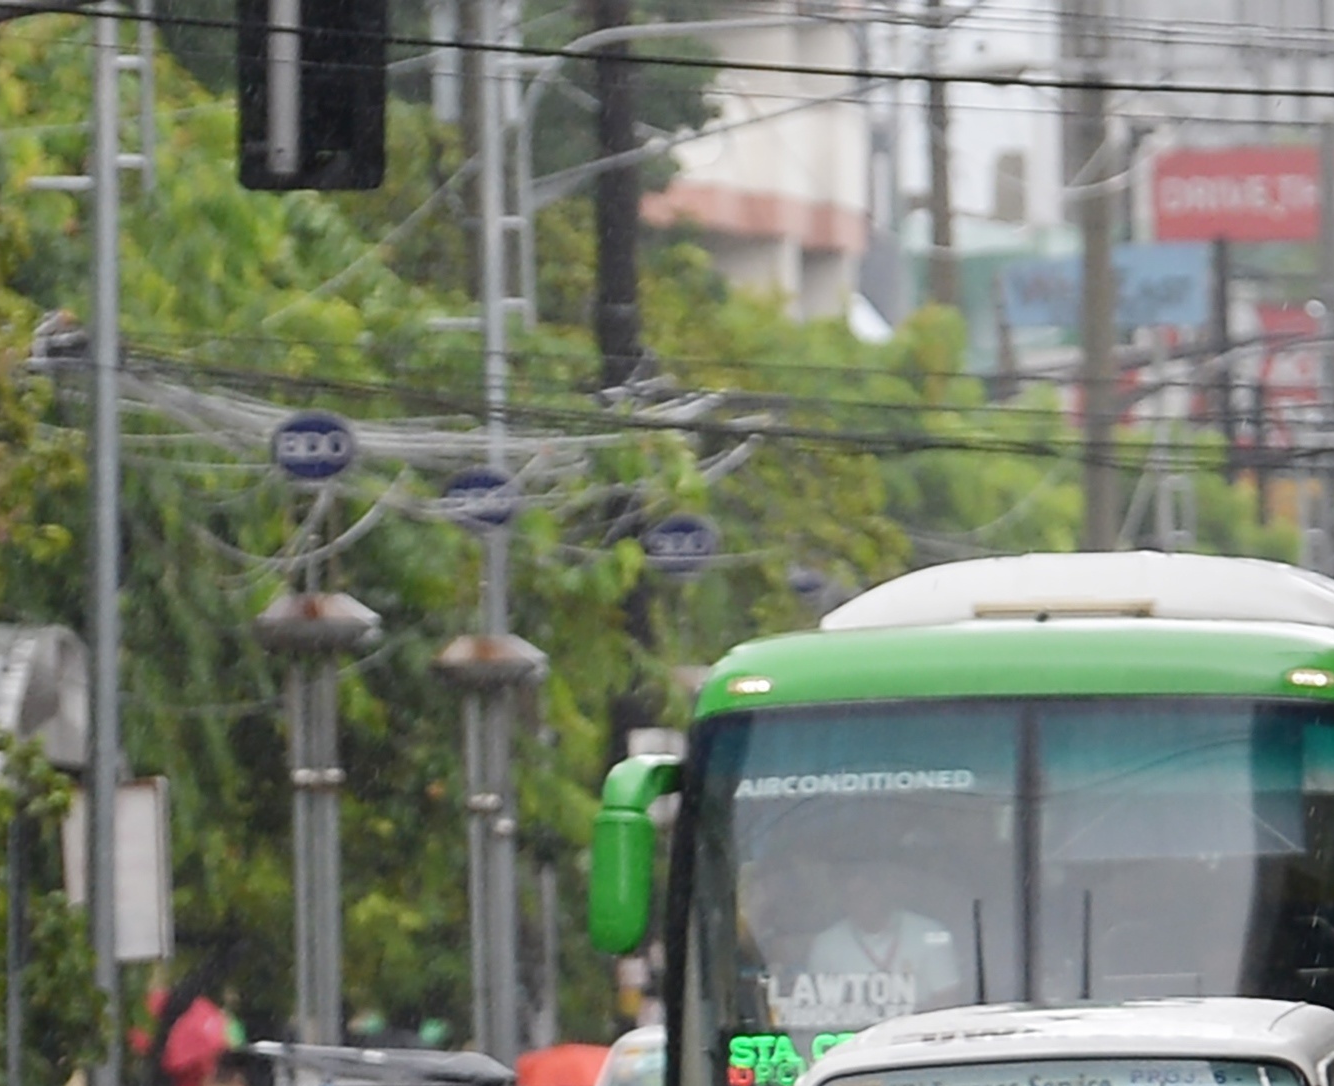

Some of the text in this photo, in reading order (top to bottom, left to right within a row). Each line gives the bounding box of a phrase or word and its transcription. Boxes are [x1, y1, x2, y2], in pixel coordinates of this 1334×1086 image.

[278, 430, 351, 462] BDO
[734, 768, 974, 799] AIRCONDITIONED
[768, 970, 916, 1007] LAWTON
